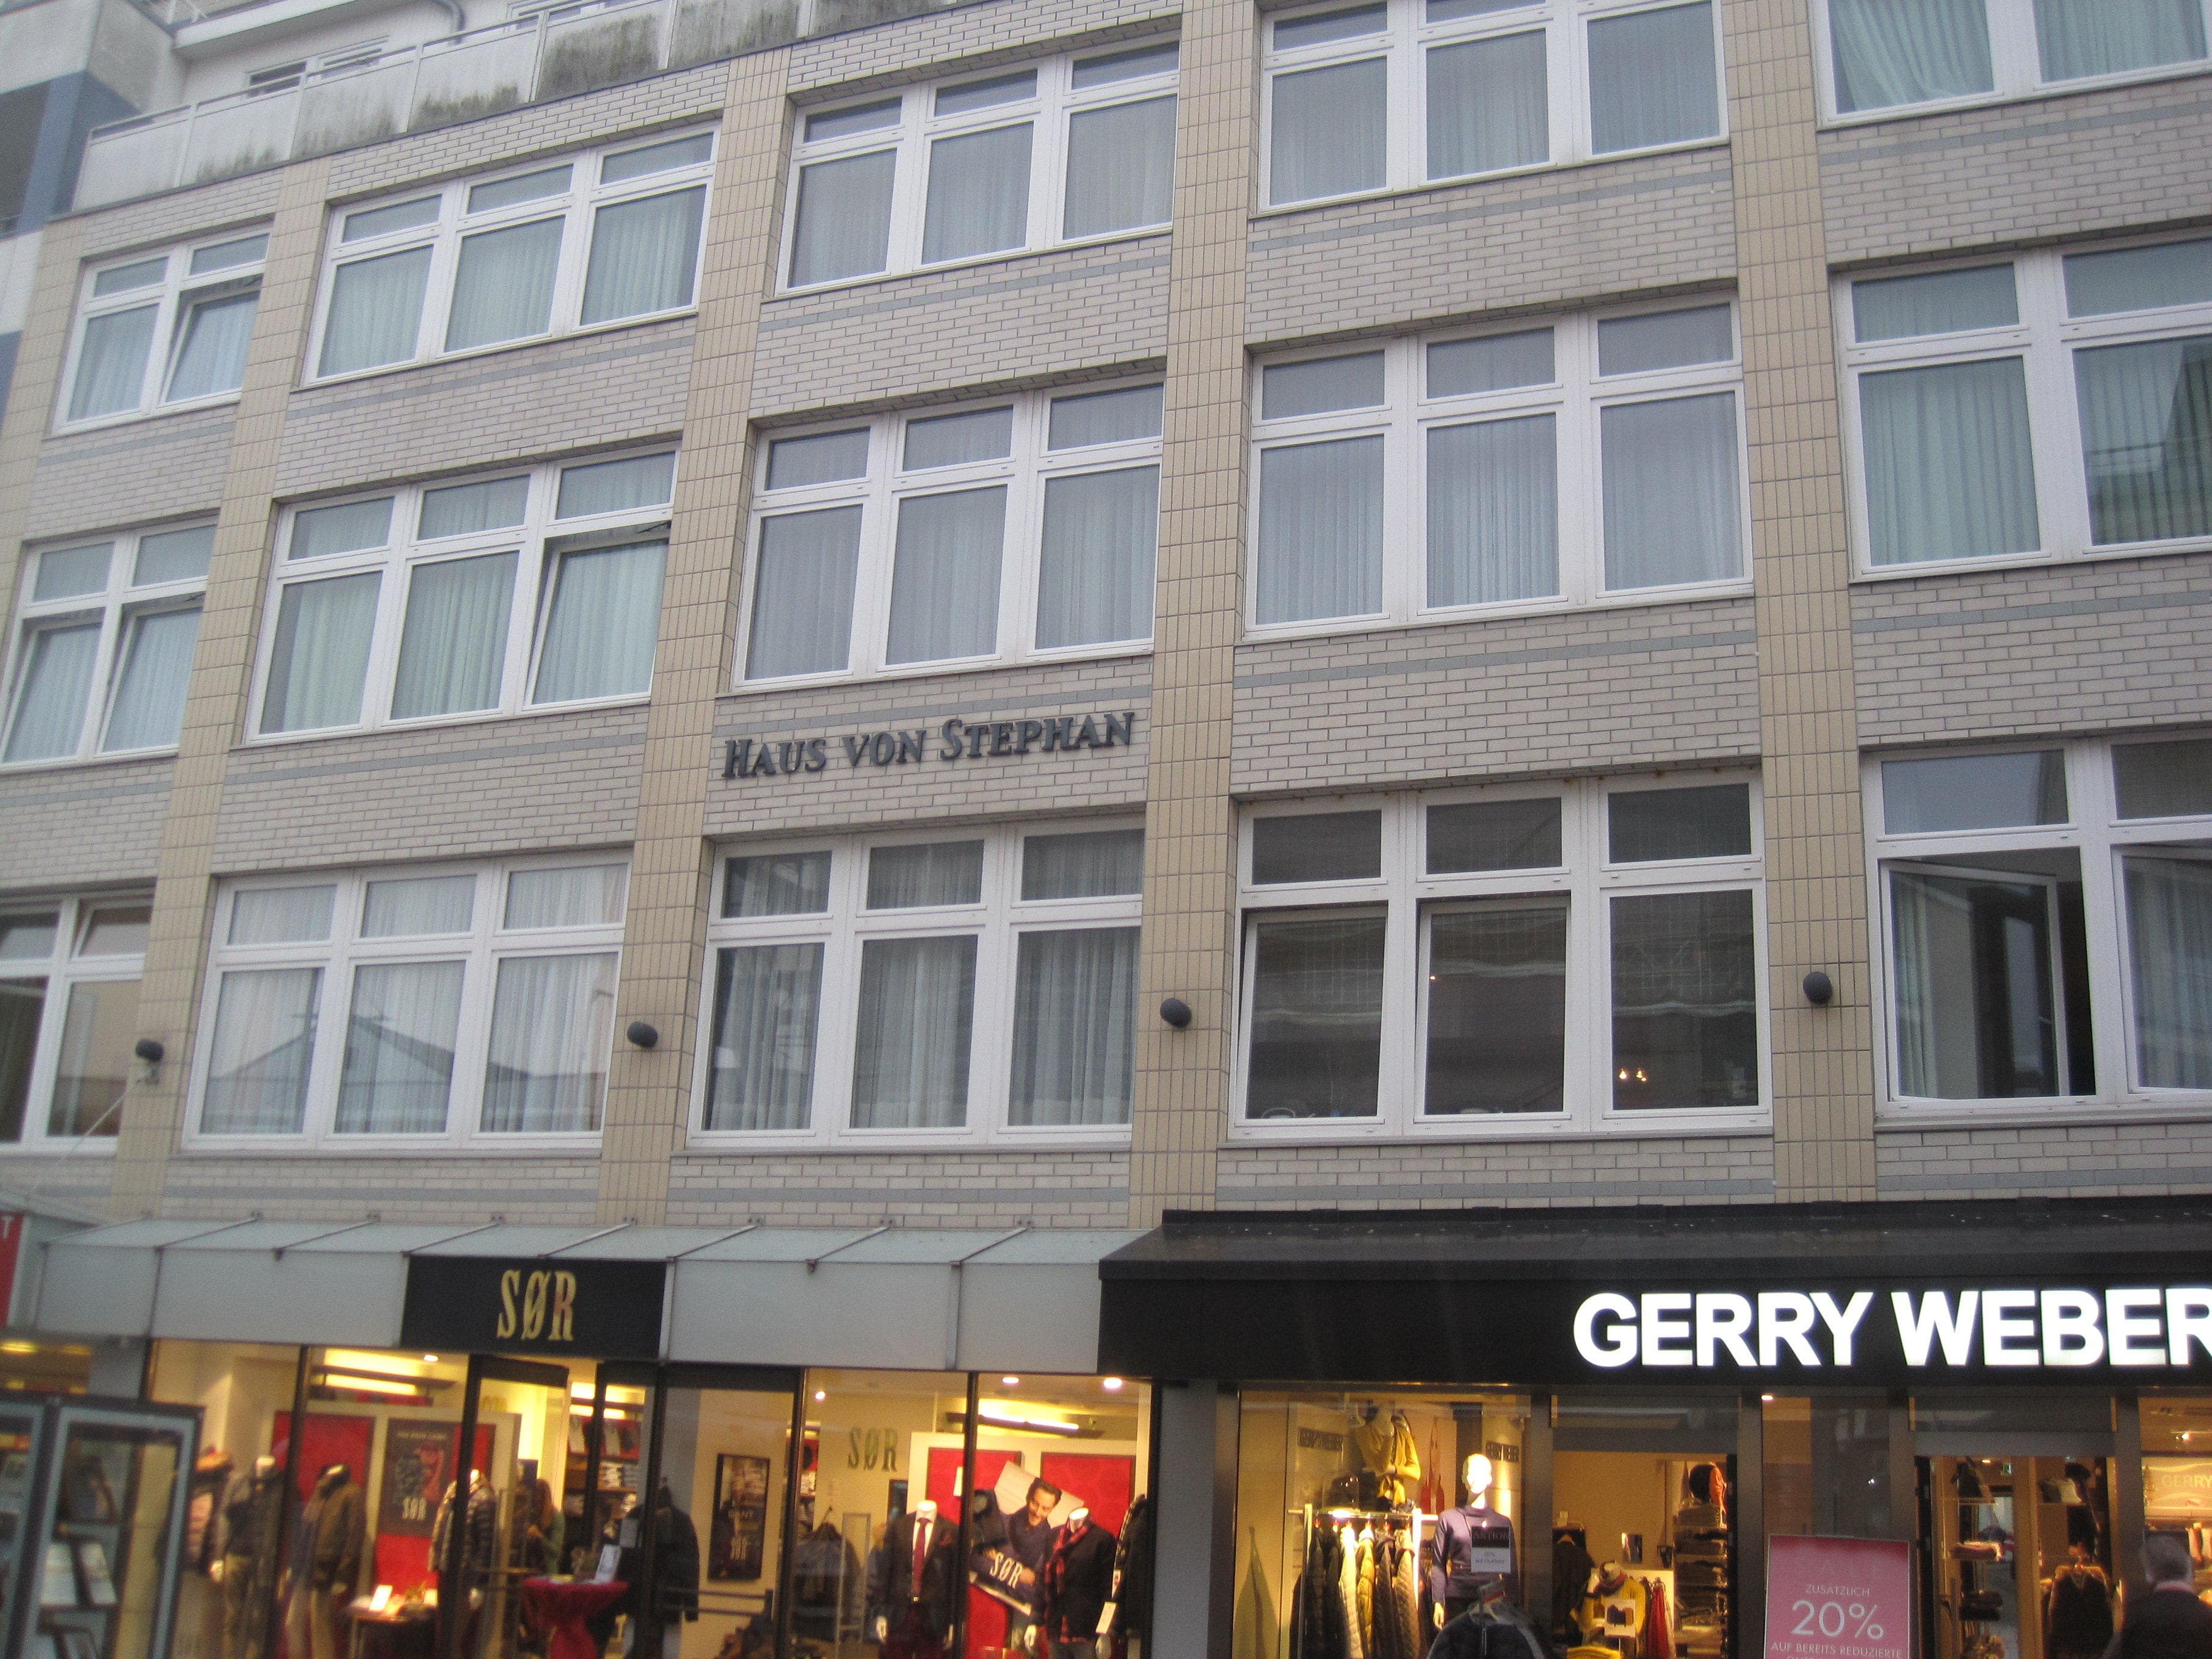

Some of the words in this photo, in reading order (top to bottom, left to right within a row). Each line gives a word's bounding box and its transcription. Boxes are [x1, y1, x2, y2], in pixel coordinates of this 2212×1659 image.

[721, 739, 826, 779] HAUS
[842, 729, 927, 767] VON
[939, 711, 1135, 761] STEPHAN
[497, 1270, 577, 1342] SØR
[1573, 1292, 1874, 1367] GERRY
[1889, 1287, 2212, 1366] WEBER
[1771, 1641, 1791, 1652] AUF
[1796, 1643, 1836, 1655] BEREITS
[1840, 1646, 1902, 1659] REDUZIERTE
[1792, 1600, 1885, 1640] 20%
